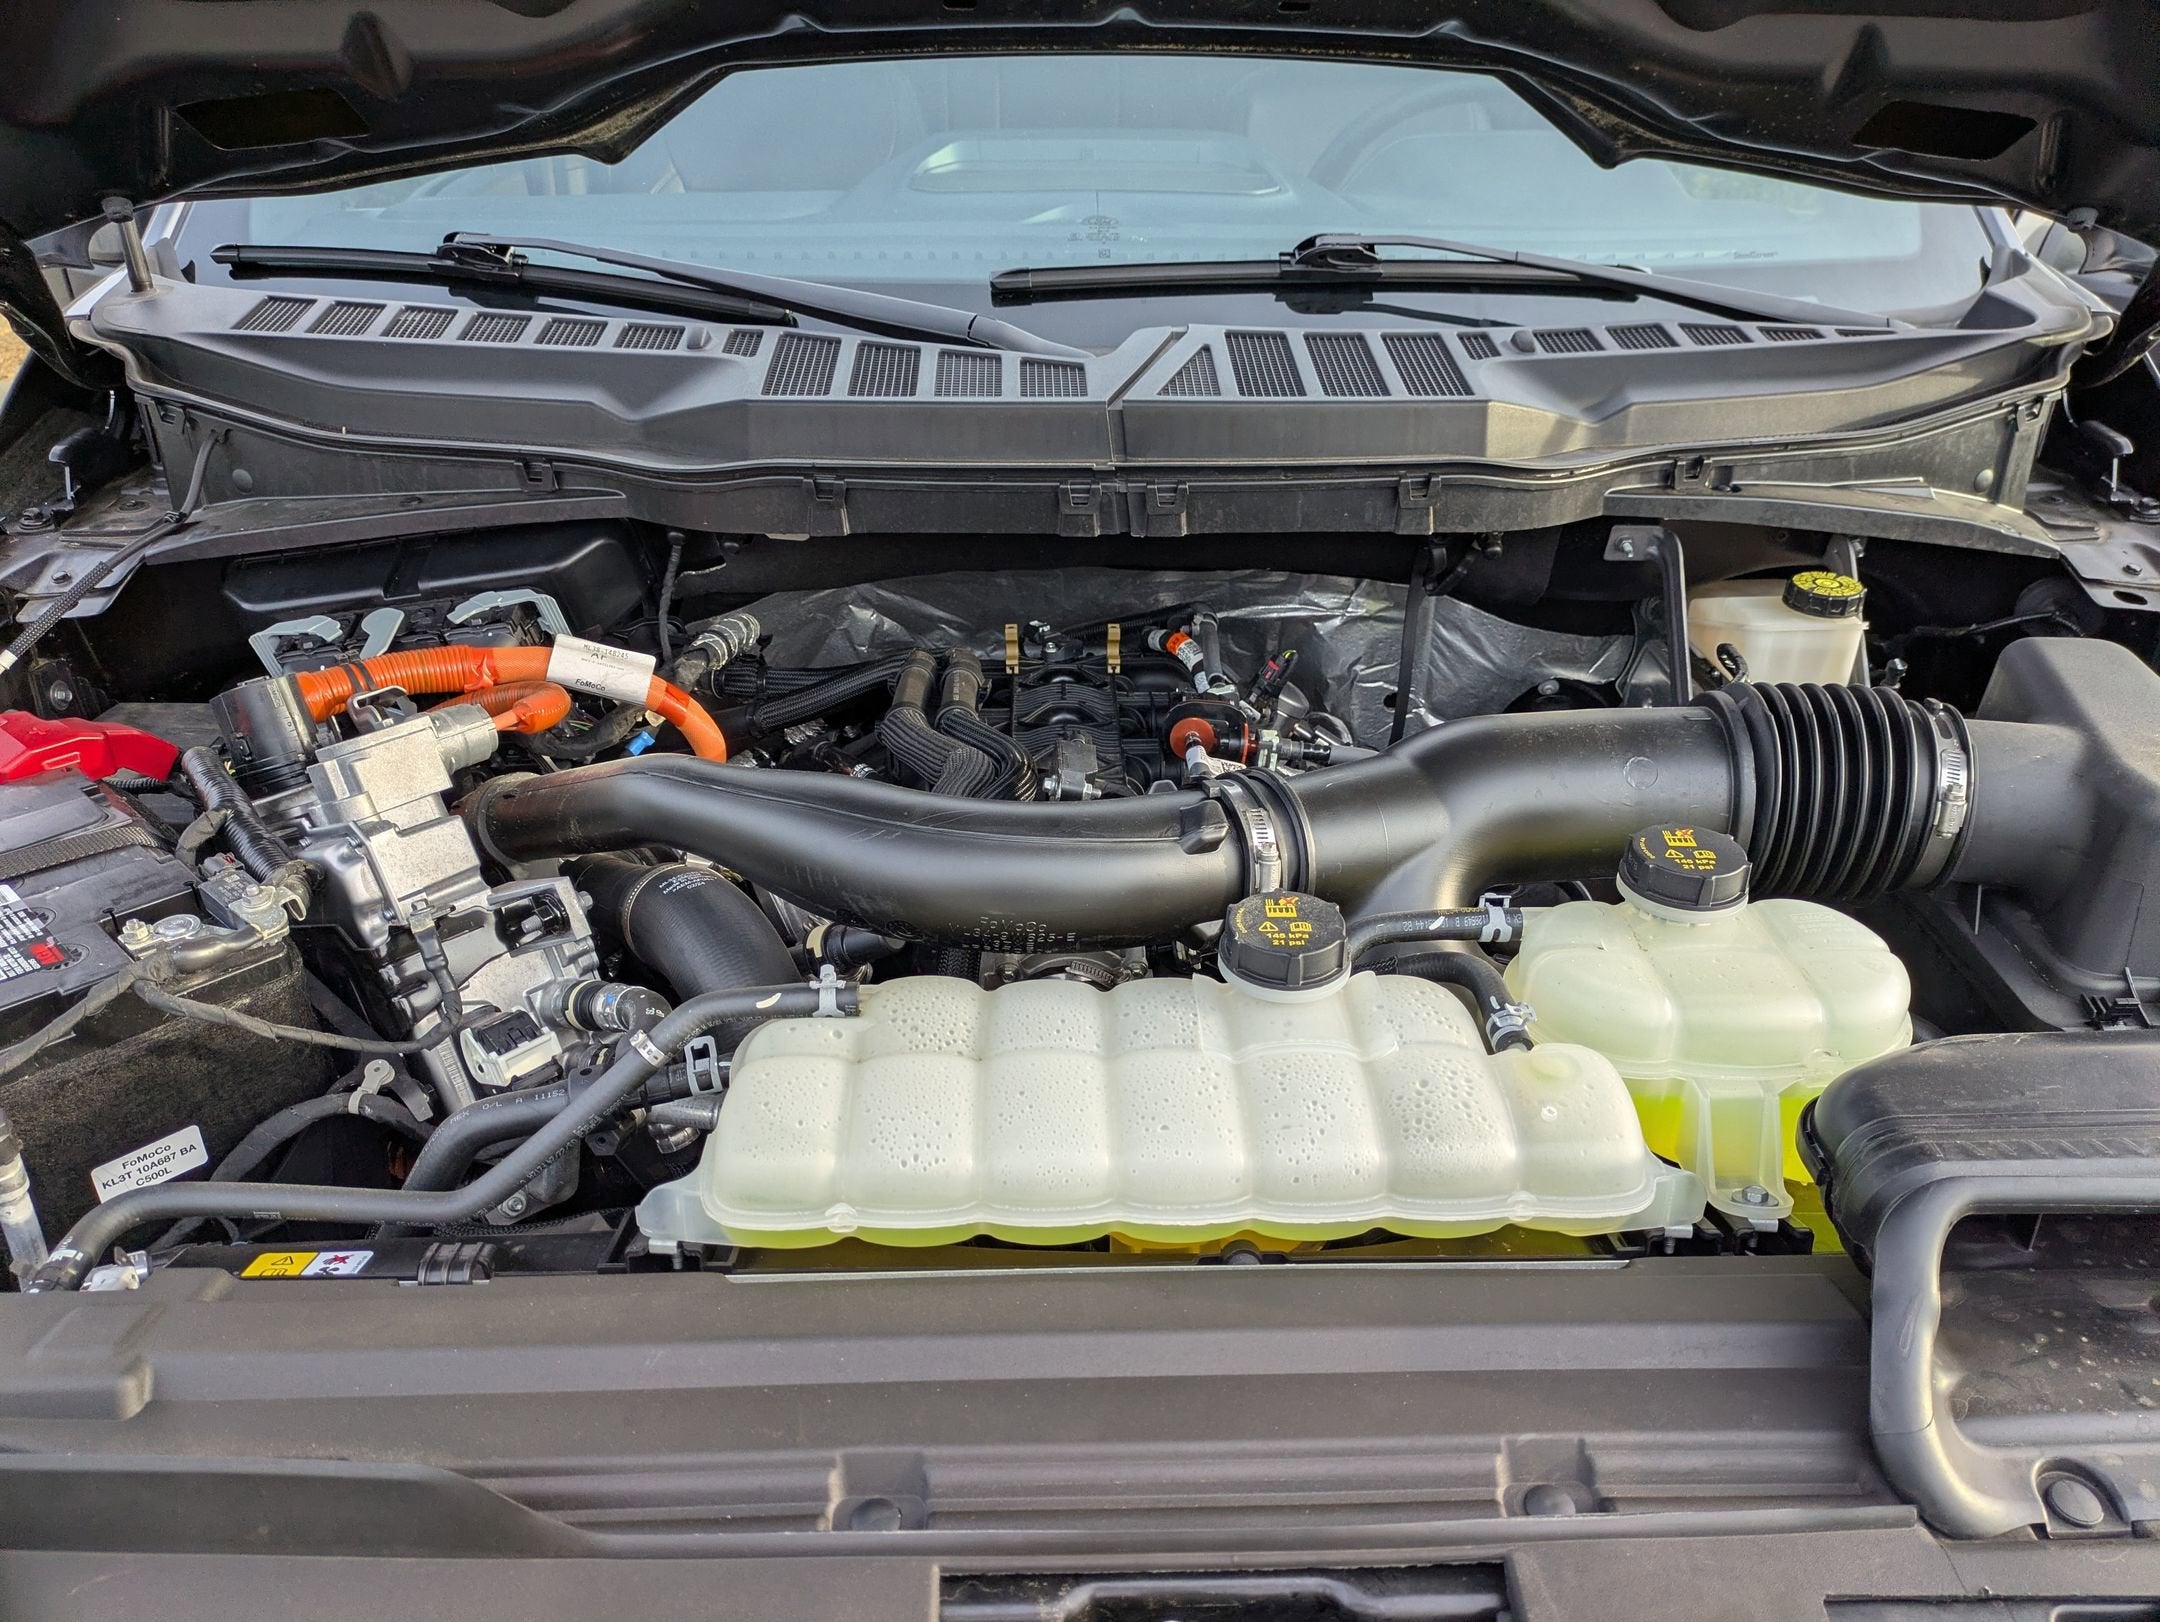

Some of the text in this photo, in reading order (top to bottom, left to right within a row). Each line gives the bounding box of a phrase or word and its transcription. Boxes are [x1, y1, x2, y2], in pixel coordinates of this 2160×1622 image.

[575, 678, 606, 692] FoMoCo
[101, 1143, 198, 1190] KL3T 10A687 BA
[121, 1144, 172, 1170] FoMoCo
[135, 1167, 173, 1187] C500L
